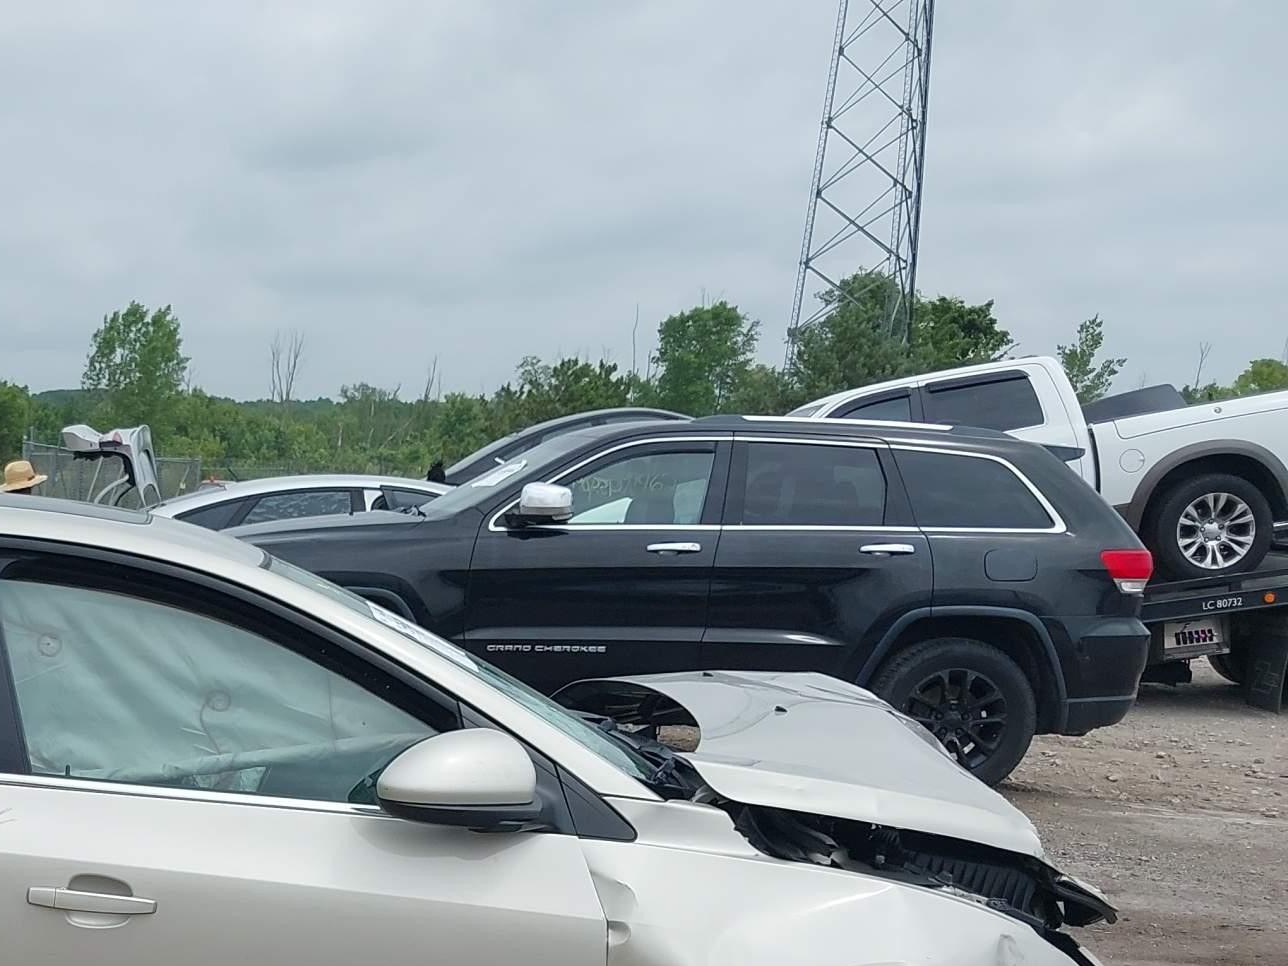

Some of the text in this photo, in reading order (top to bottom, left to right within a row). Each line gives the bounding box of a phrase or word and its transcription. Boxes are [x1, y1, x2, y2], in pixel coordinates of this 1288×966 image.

[1202, 597, 1243, 610] LC 80732
[486, 644, 607, 653] GRAND CHEROKEE
